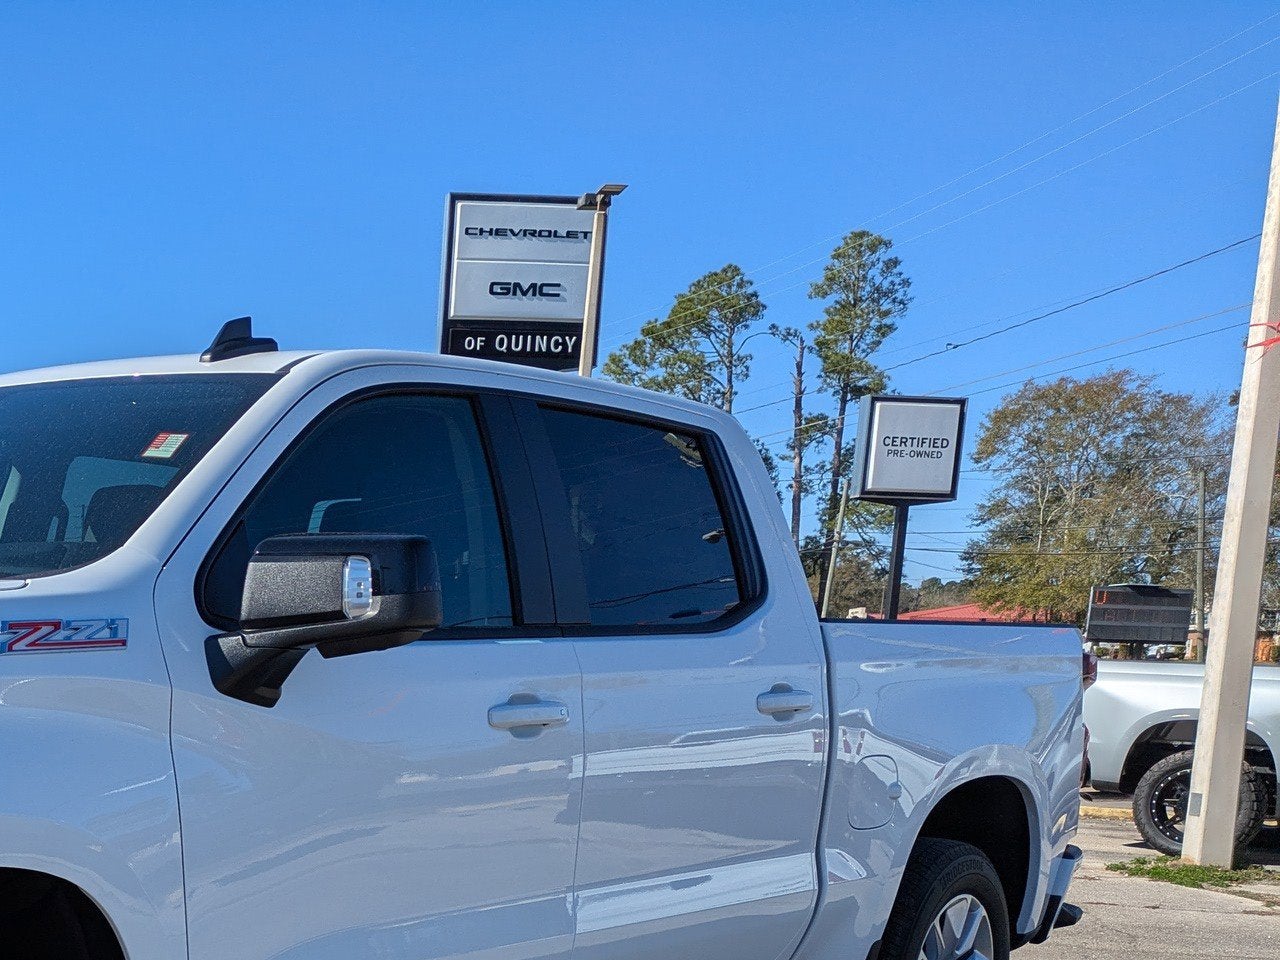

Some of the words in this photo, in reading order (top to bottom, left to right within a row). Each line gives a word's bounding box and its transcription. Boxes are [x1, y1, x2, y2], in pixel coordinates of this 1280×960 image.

[464, 226, 593, 240] CHEVROLET
[488, 281, 562, 298] GMC
[464, 336, 486, 351] OF
[495, 334, 578, 353] QUINCY
[883, 435, 950, 448] CERTIFIED
[886, 449, 943, 459] PRE-OWNED
